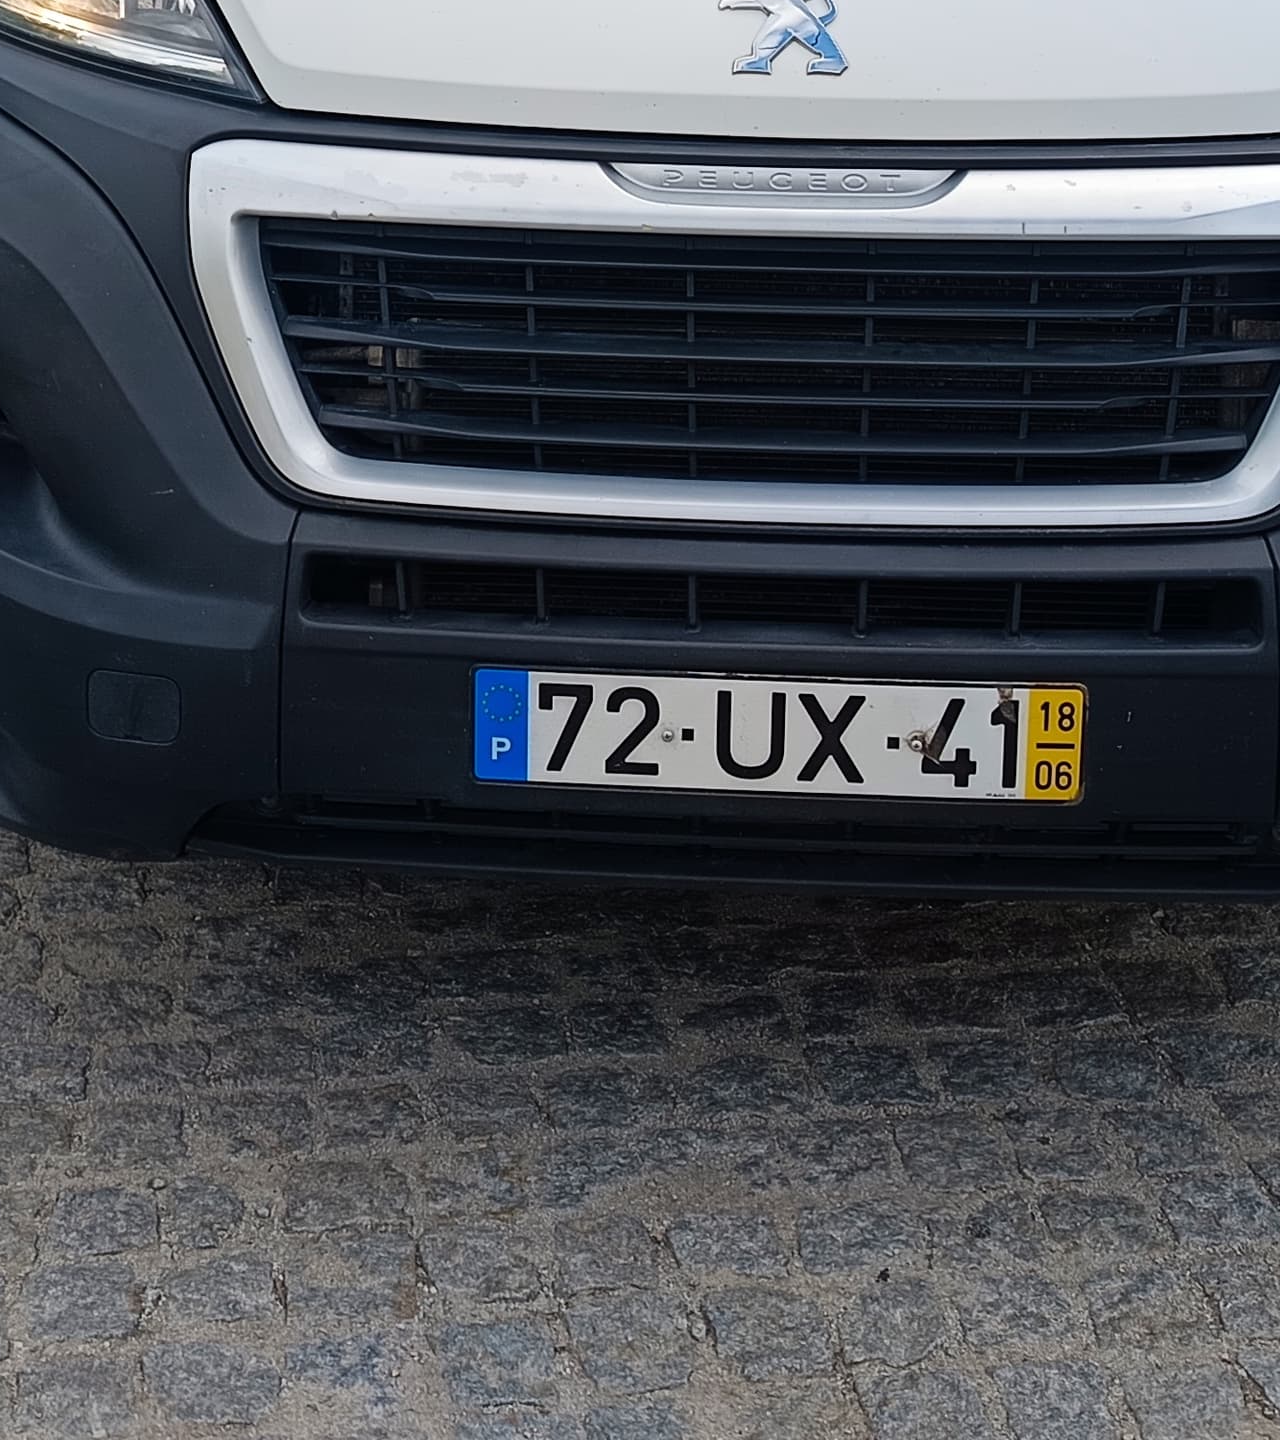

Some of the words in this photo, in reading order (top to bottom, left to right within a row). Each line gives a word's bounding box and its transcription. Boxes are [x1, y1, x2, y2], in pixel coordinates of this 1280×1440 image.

[662, 168, 901, 193] PEUGEOT
[1040, 701, 1076, 732] 18
[490, 735, 512, 761] P
[1034, 760, 1073, 791] 06
